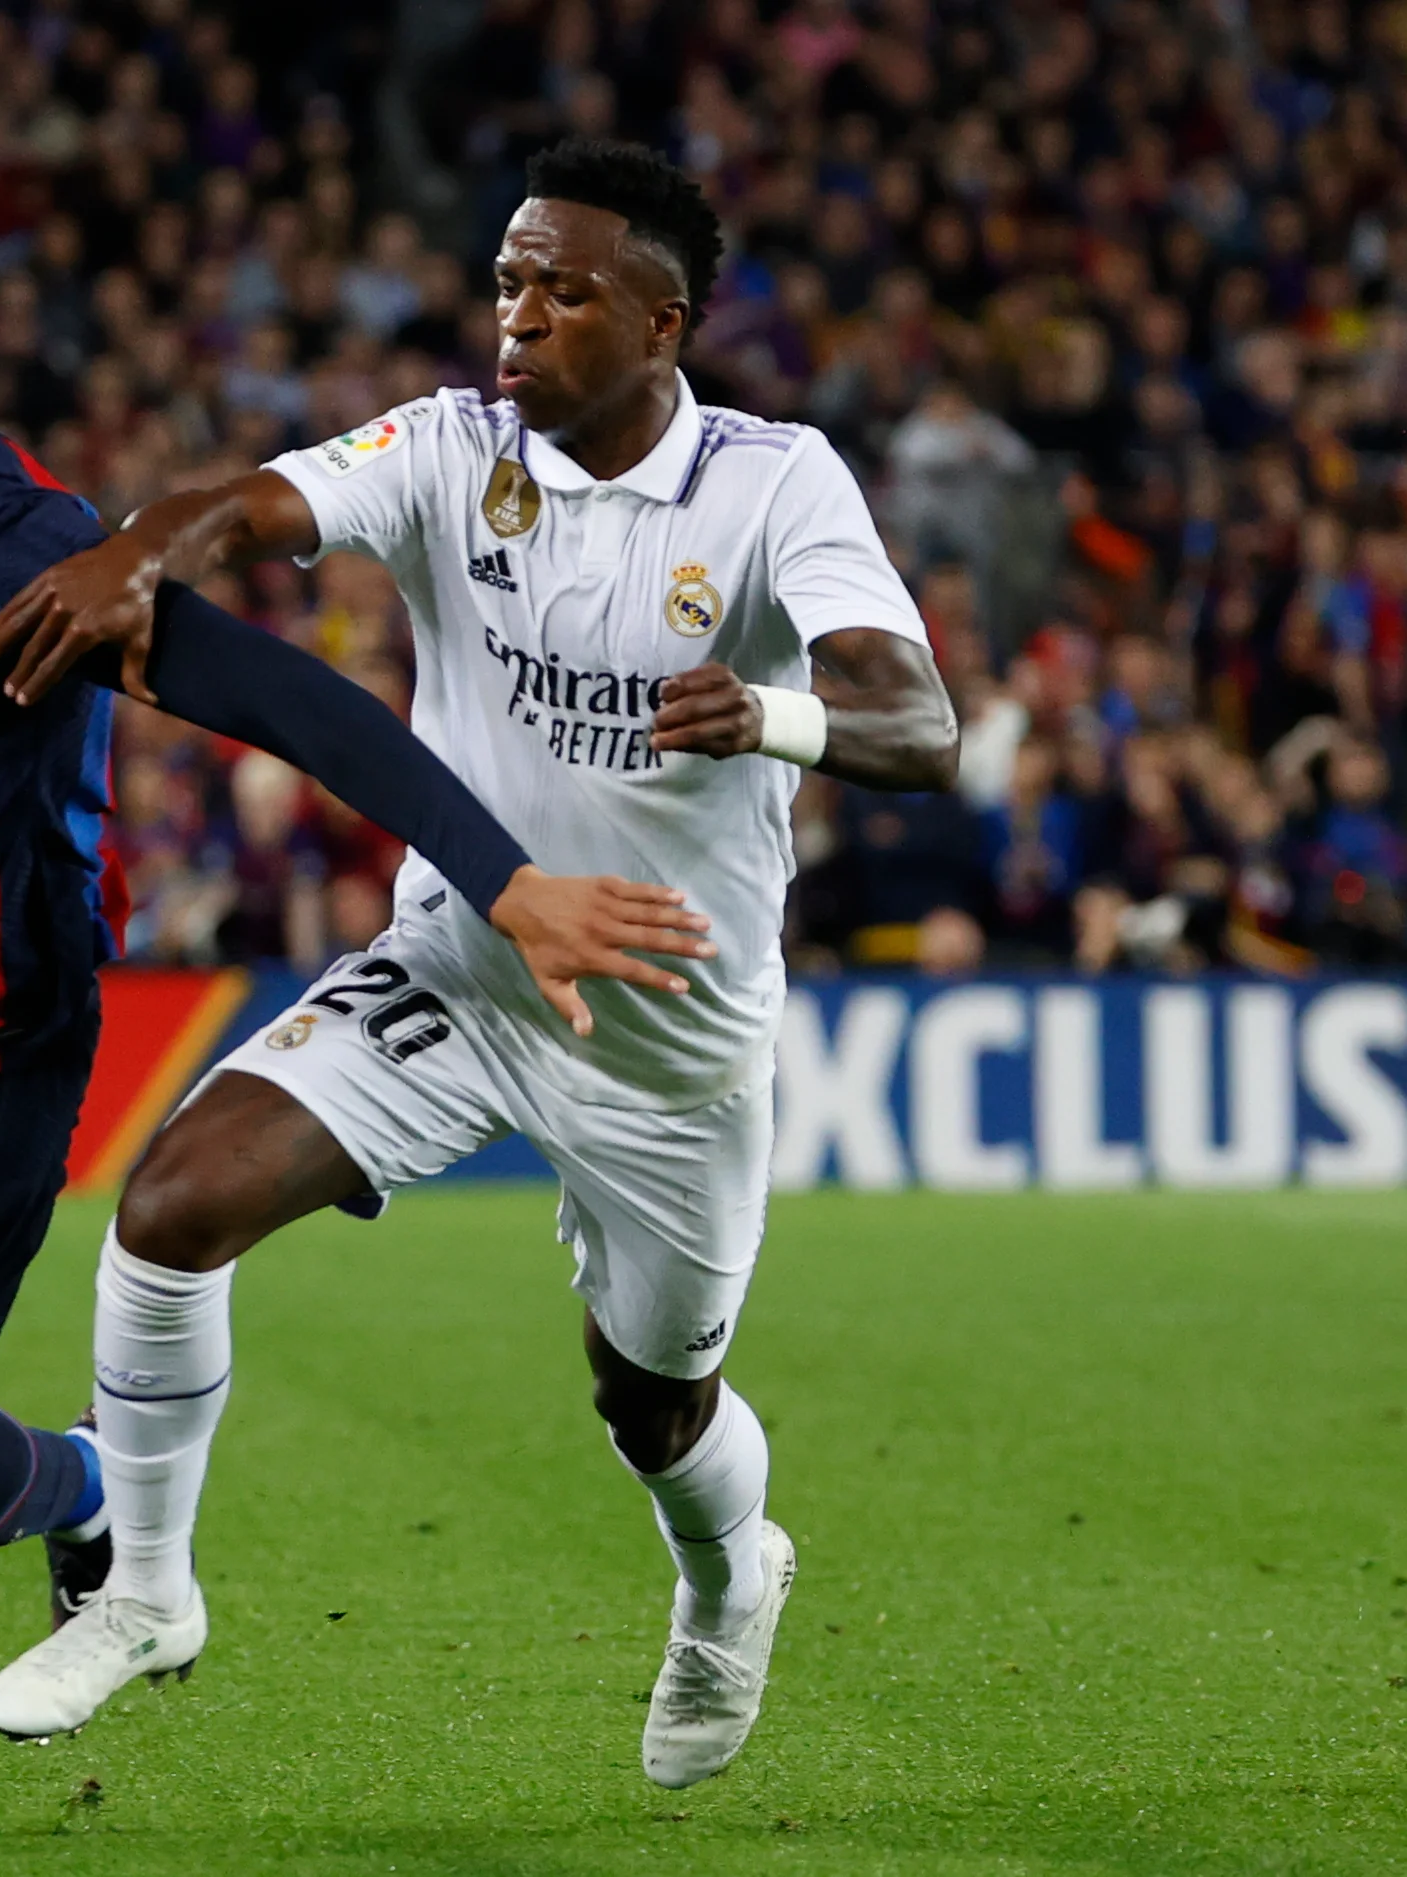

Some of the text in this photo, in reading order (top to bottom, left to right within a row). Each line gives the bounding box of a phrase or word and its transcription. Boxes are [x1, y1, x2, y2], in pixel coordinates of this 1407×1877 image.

[321, 441, 350, 470] Liga
[494, 506, 520, 525] FIFA
[484, 625, 672, 717] Emirat
[300, 957, 451, 1065] 20
[774, 983, 1407, 1190] XCLUS
